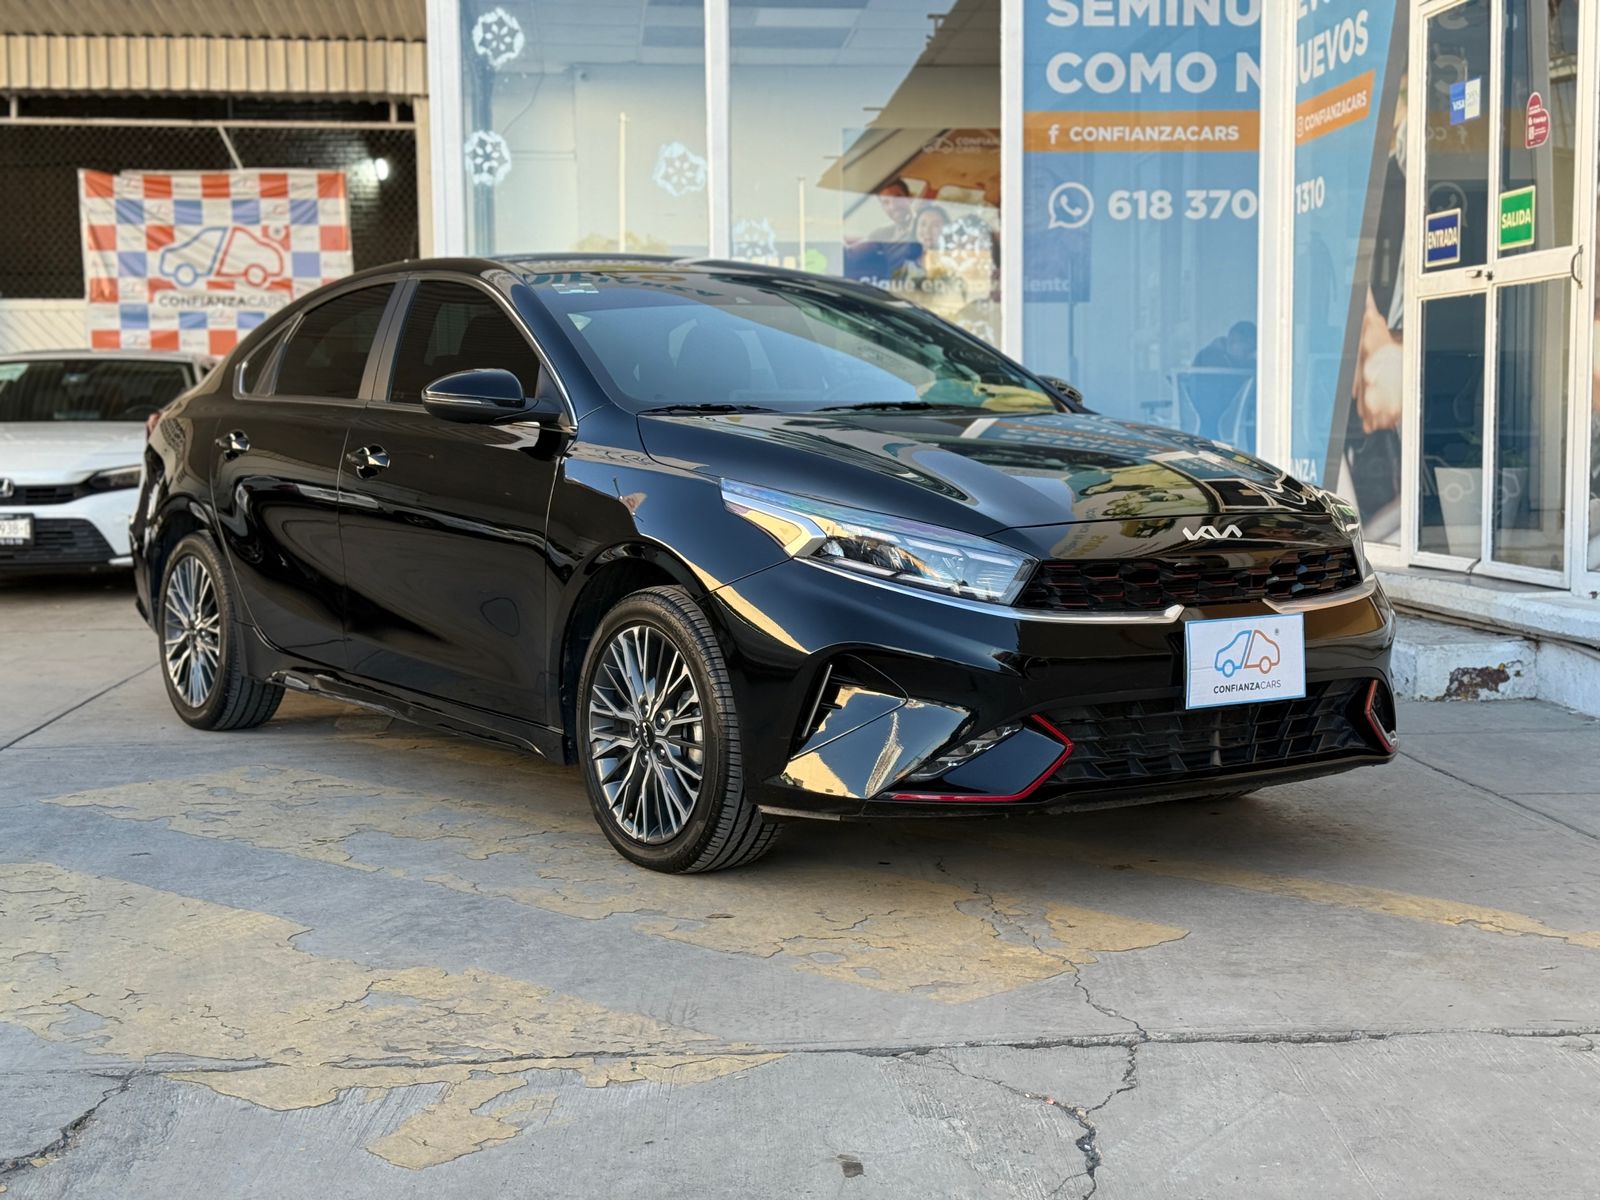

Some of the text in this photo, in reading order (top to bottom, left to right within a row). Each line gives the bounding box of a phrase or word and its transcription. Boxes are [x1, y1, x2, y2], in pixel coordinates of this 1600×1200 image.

[1046, 52, 1218, 94] COMO
[1305, 89, 1367, 131] CONFIANZACARS
[1069, 125, 1239, 142] CONFIANZACARS
[1107, 188, 1258, 220] 618 370
[1296, 176, 1325, 214] 1310
[1501, 208, 1532, 229] SALIDA
[1428, 226, 1458, 249] ENTRADA
[1213, 680, 1282, 694] CONFIANZACARS
